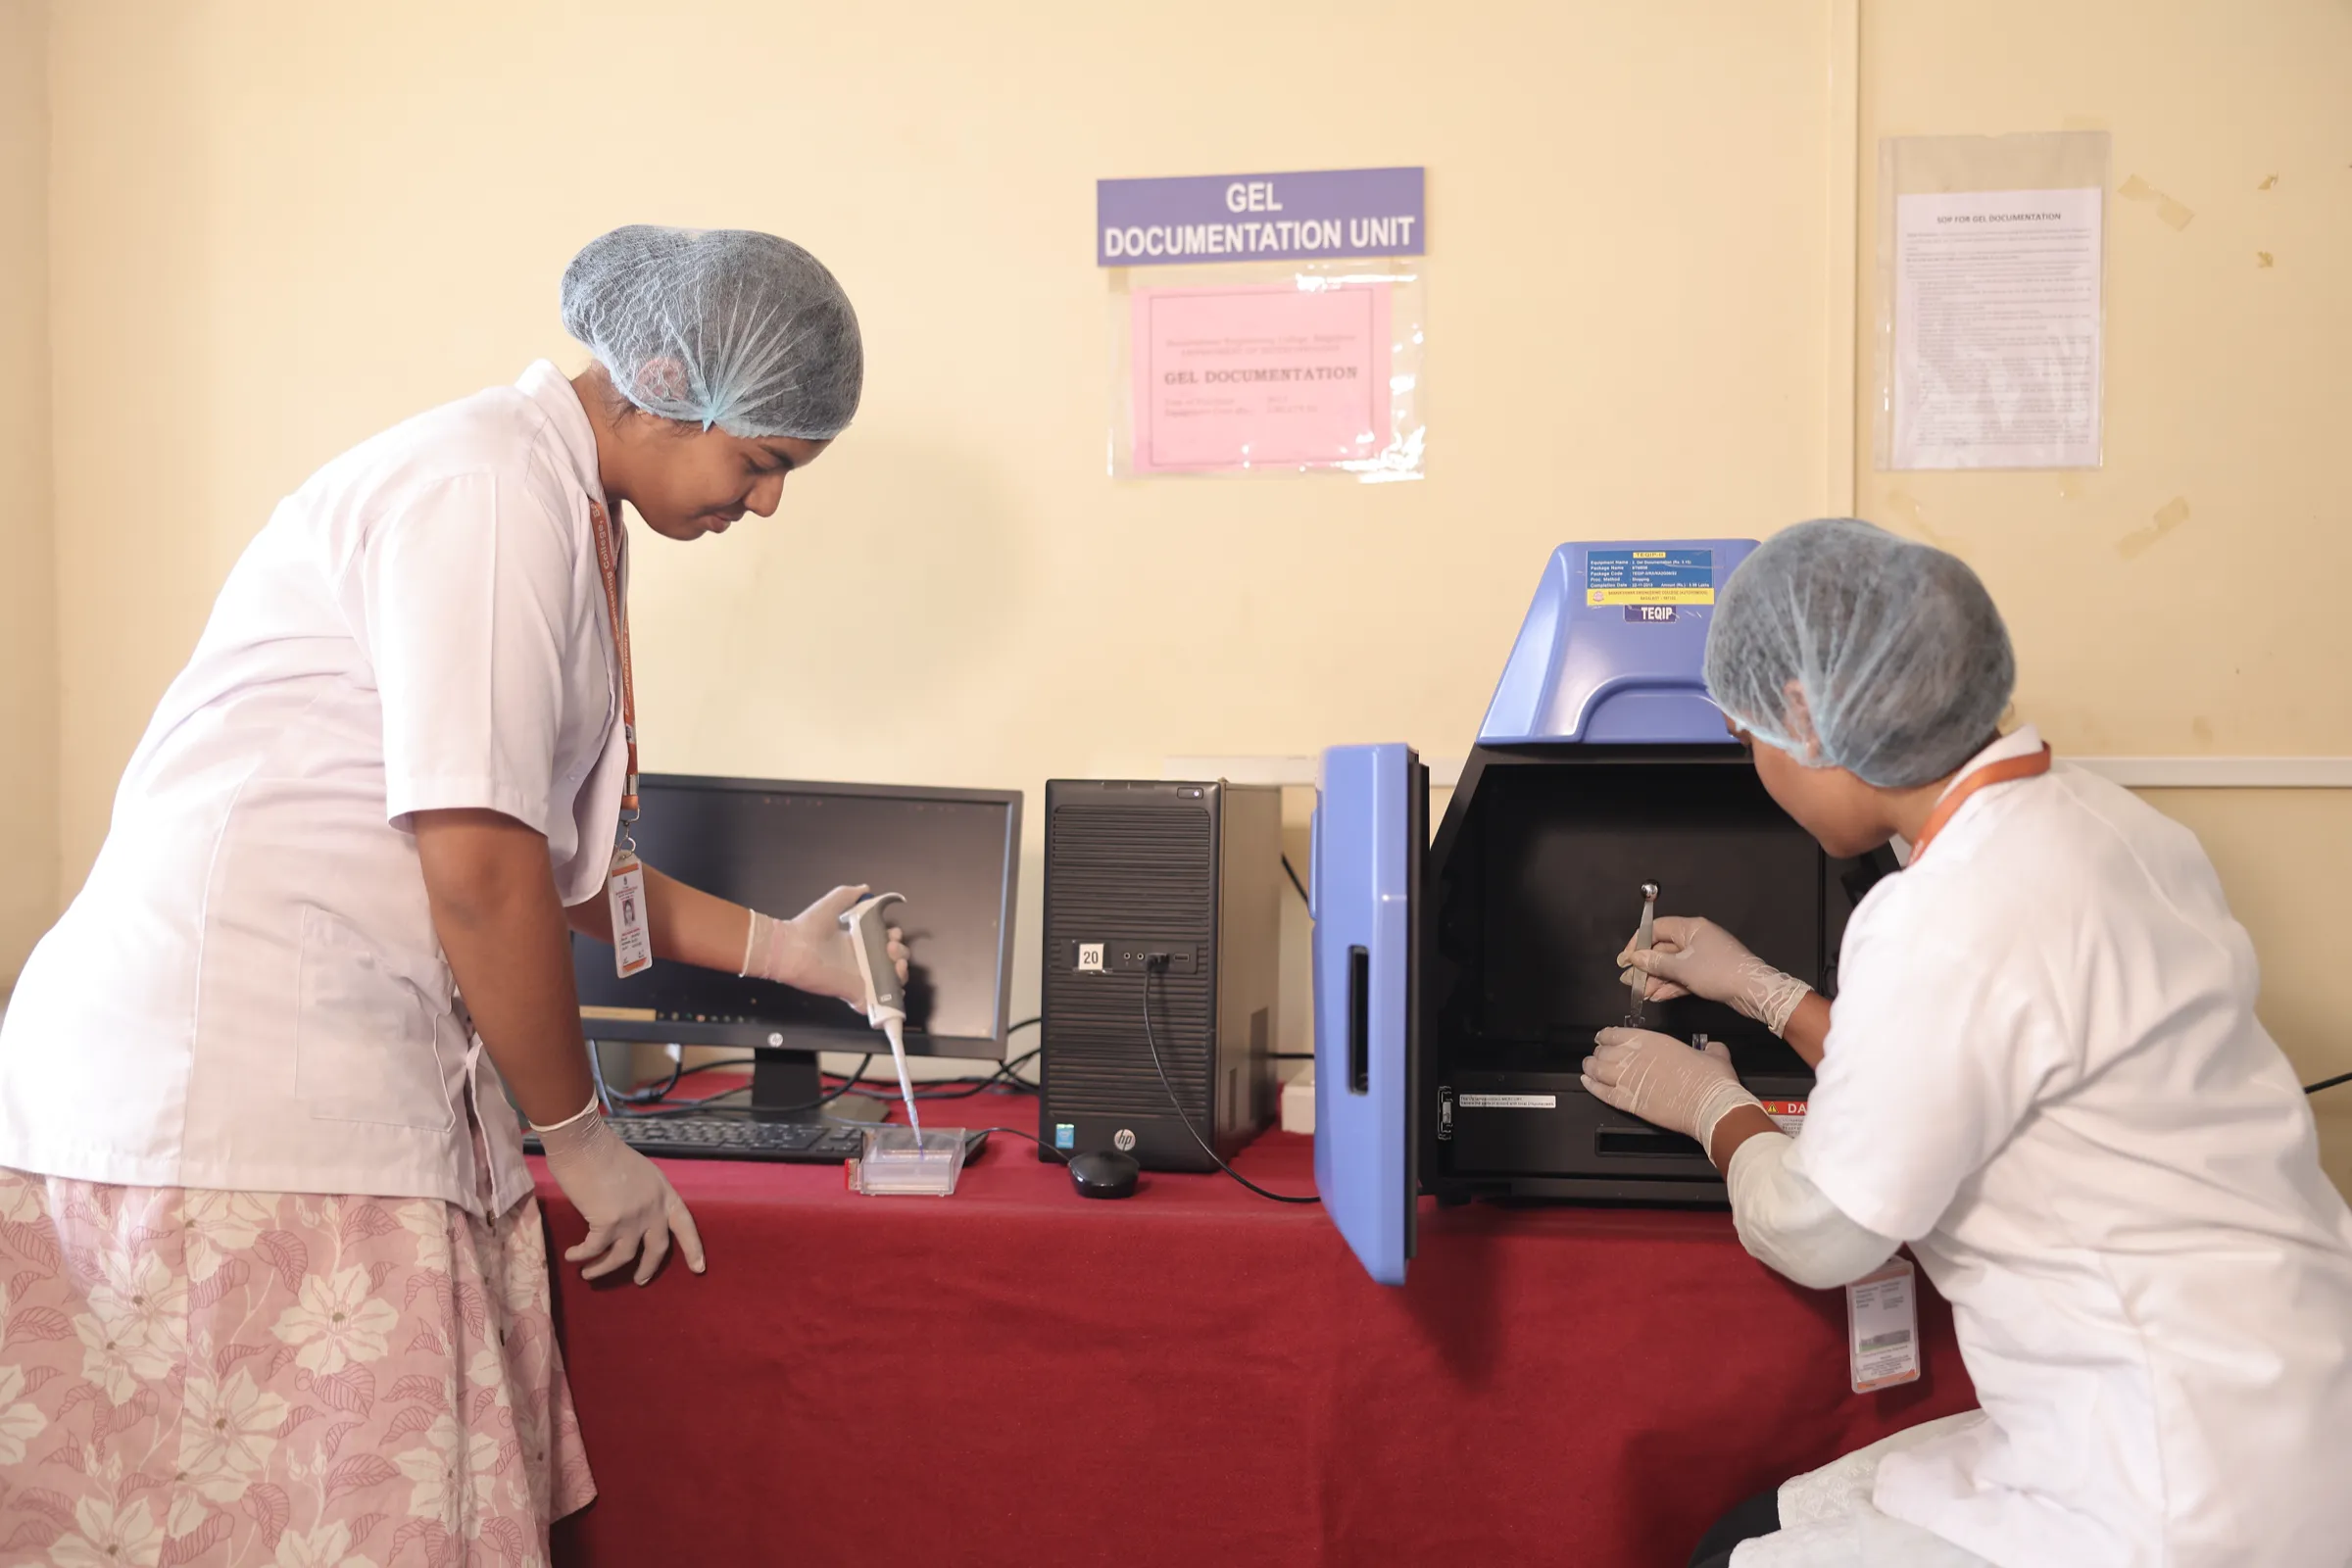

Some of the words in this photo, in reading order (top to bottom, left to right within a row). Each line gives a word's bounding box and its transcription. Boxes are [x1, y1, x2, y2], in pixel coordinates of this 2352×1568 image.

[1226, 182, 1283, 214] GEL
[1954, 215, 1971, 223] FOR
[1973, 214, 1986, 223] GEL
[1988, 212, 2061, 222] DOCUMENTATION
[1104, 220, 1342, 258] DOCUMENTATION
[1349, 216, 1415, 248] UNIT
[1164, 370, 1200, 385] GEL
[1204, 366, 1358, 384] DOCUMENTATION
[1641, 607, 1673, 620] TEQIP
[1083, 951, 1100, 965] 20
[1116, 1129, 1135, 1152] hp
